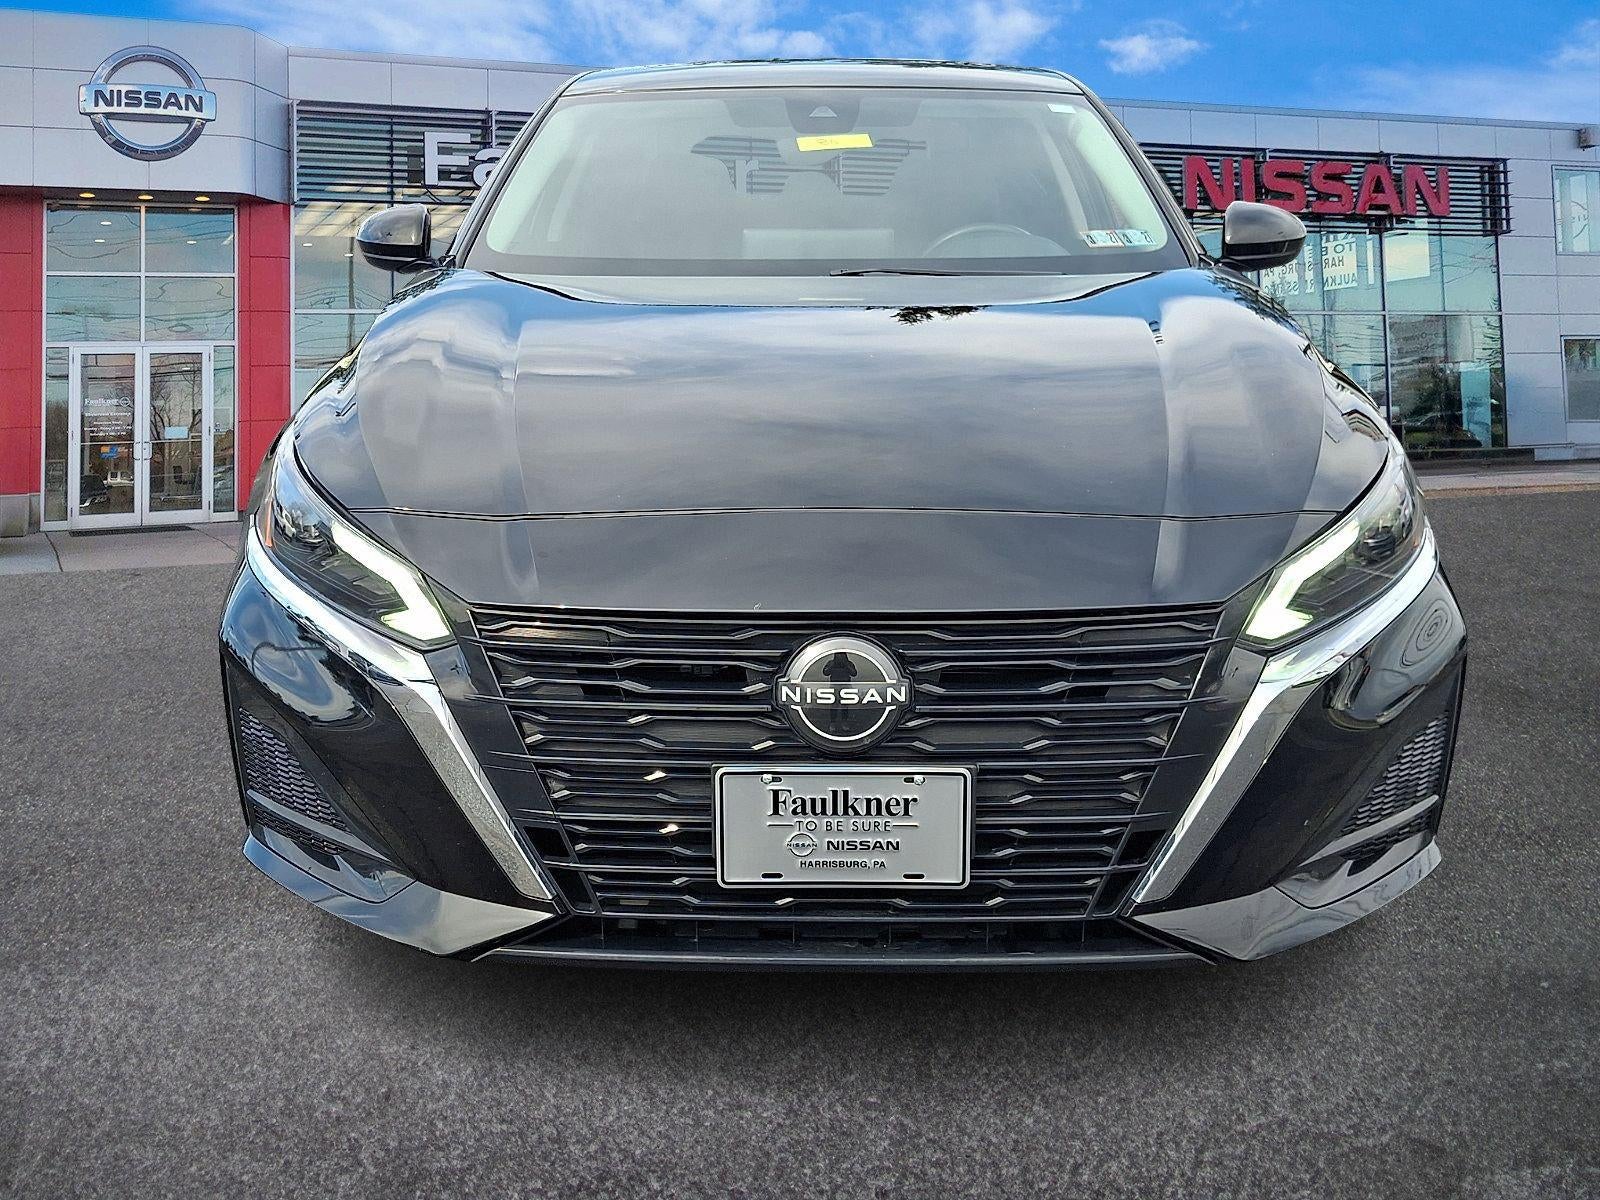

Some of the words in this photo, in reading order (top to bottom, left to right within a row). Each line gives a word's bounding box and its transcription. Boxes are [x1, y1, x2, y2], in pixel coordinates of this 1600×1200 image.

[94, 89, 203, 113] NISSAN
[1182, 155, 1450, 217] NISSAN
[782, 686, 906, 704] NISSAN
[767, 788, 918, 817] Faulkner
[795, 820, 818, 832] TO
[825, 820, 844, 832] BE
[852, 820, 891, 832] SURE
[786, 841, 818, 849] NISSAN
[826, 840, 900, 851] NISSAN
[800, 860, 871, 870] HARRISBURG,
[873, 860, 886, 869] PA
